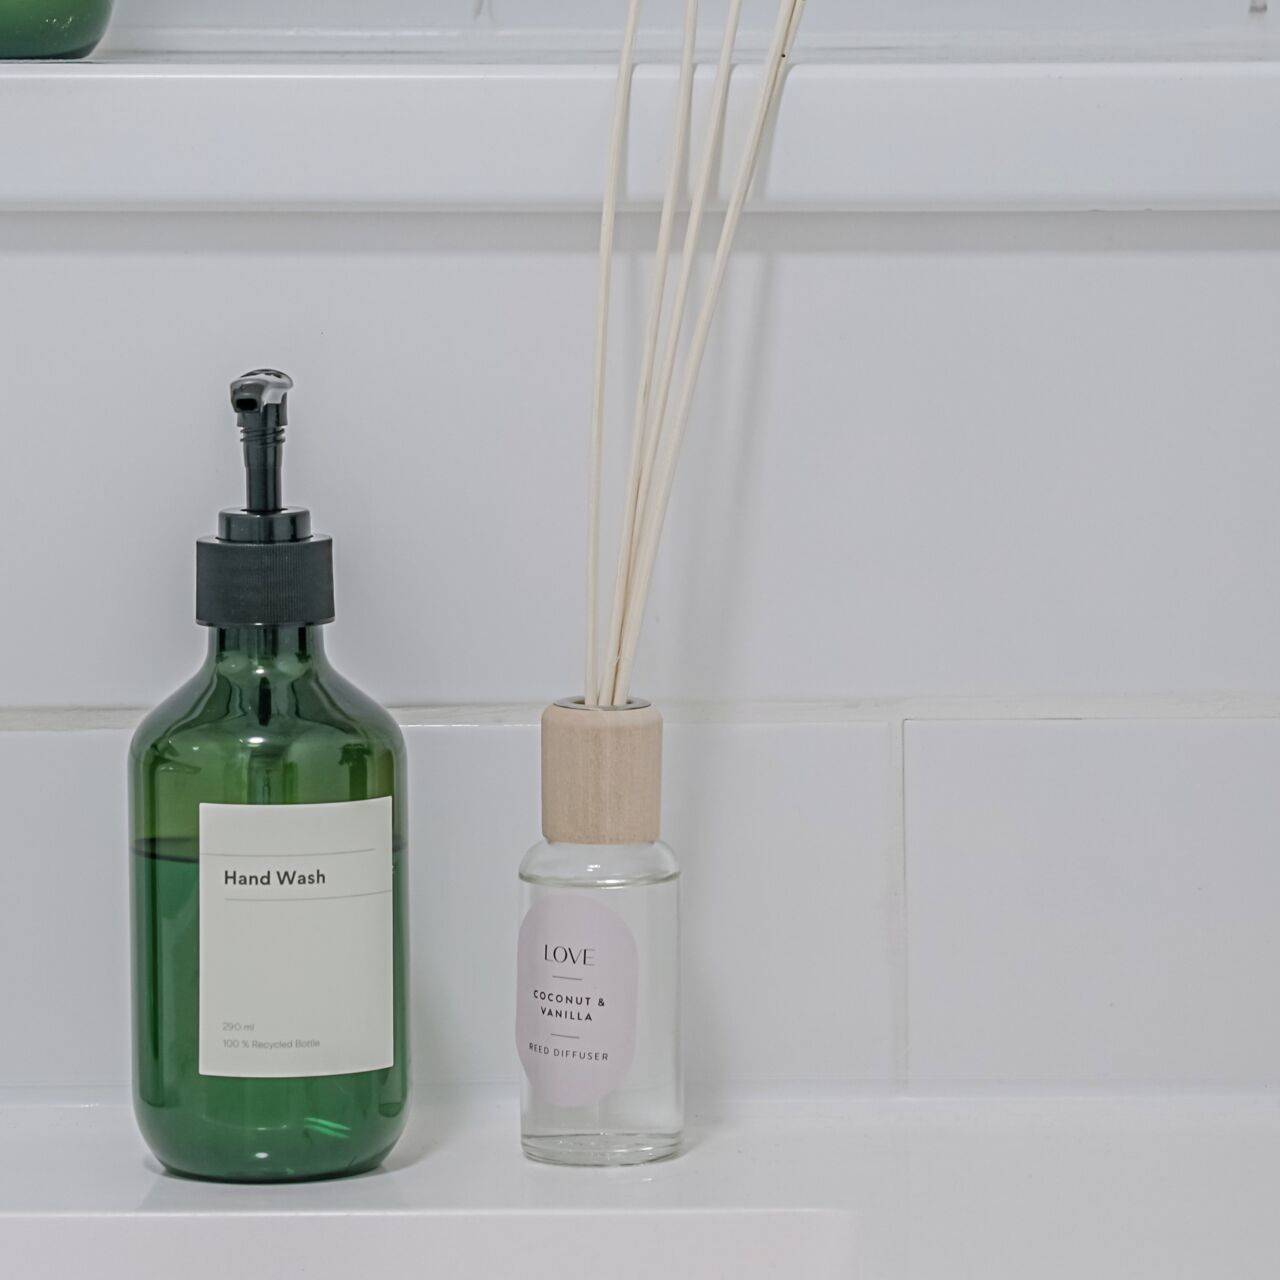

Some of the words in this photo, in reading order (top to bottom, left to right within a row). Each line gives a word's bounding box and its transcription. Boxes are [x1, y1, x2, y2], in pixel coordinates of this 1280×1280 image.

[224, 870, 271, 886] Hand
[276, 869, 326, 886] Wash
[544, 943, 596, 967] LOVE
[533, 989, 592, 1007] COCONUT
[597, 997, 606, 1007] &
[540, 1006, 593, 1022] VANILLA
[251, 1039, 293, 1050] Recycled
[295, 1038, 321, 1049] Bottle
[529, 1042, 550, 1056] REED
[553, 1048, 609, 1062] DIFFUSER
